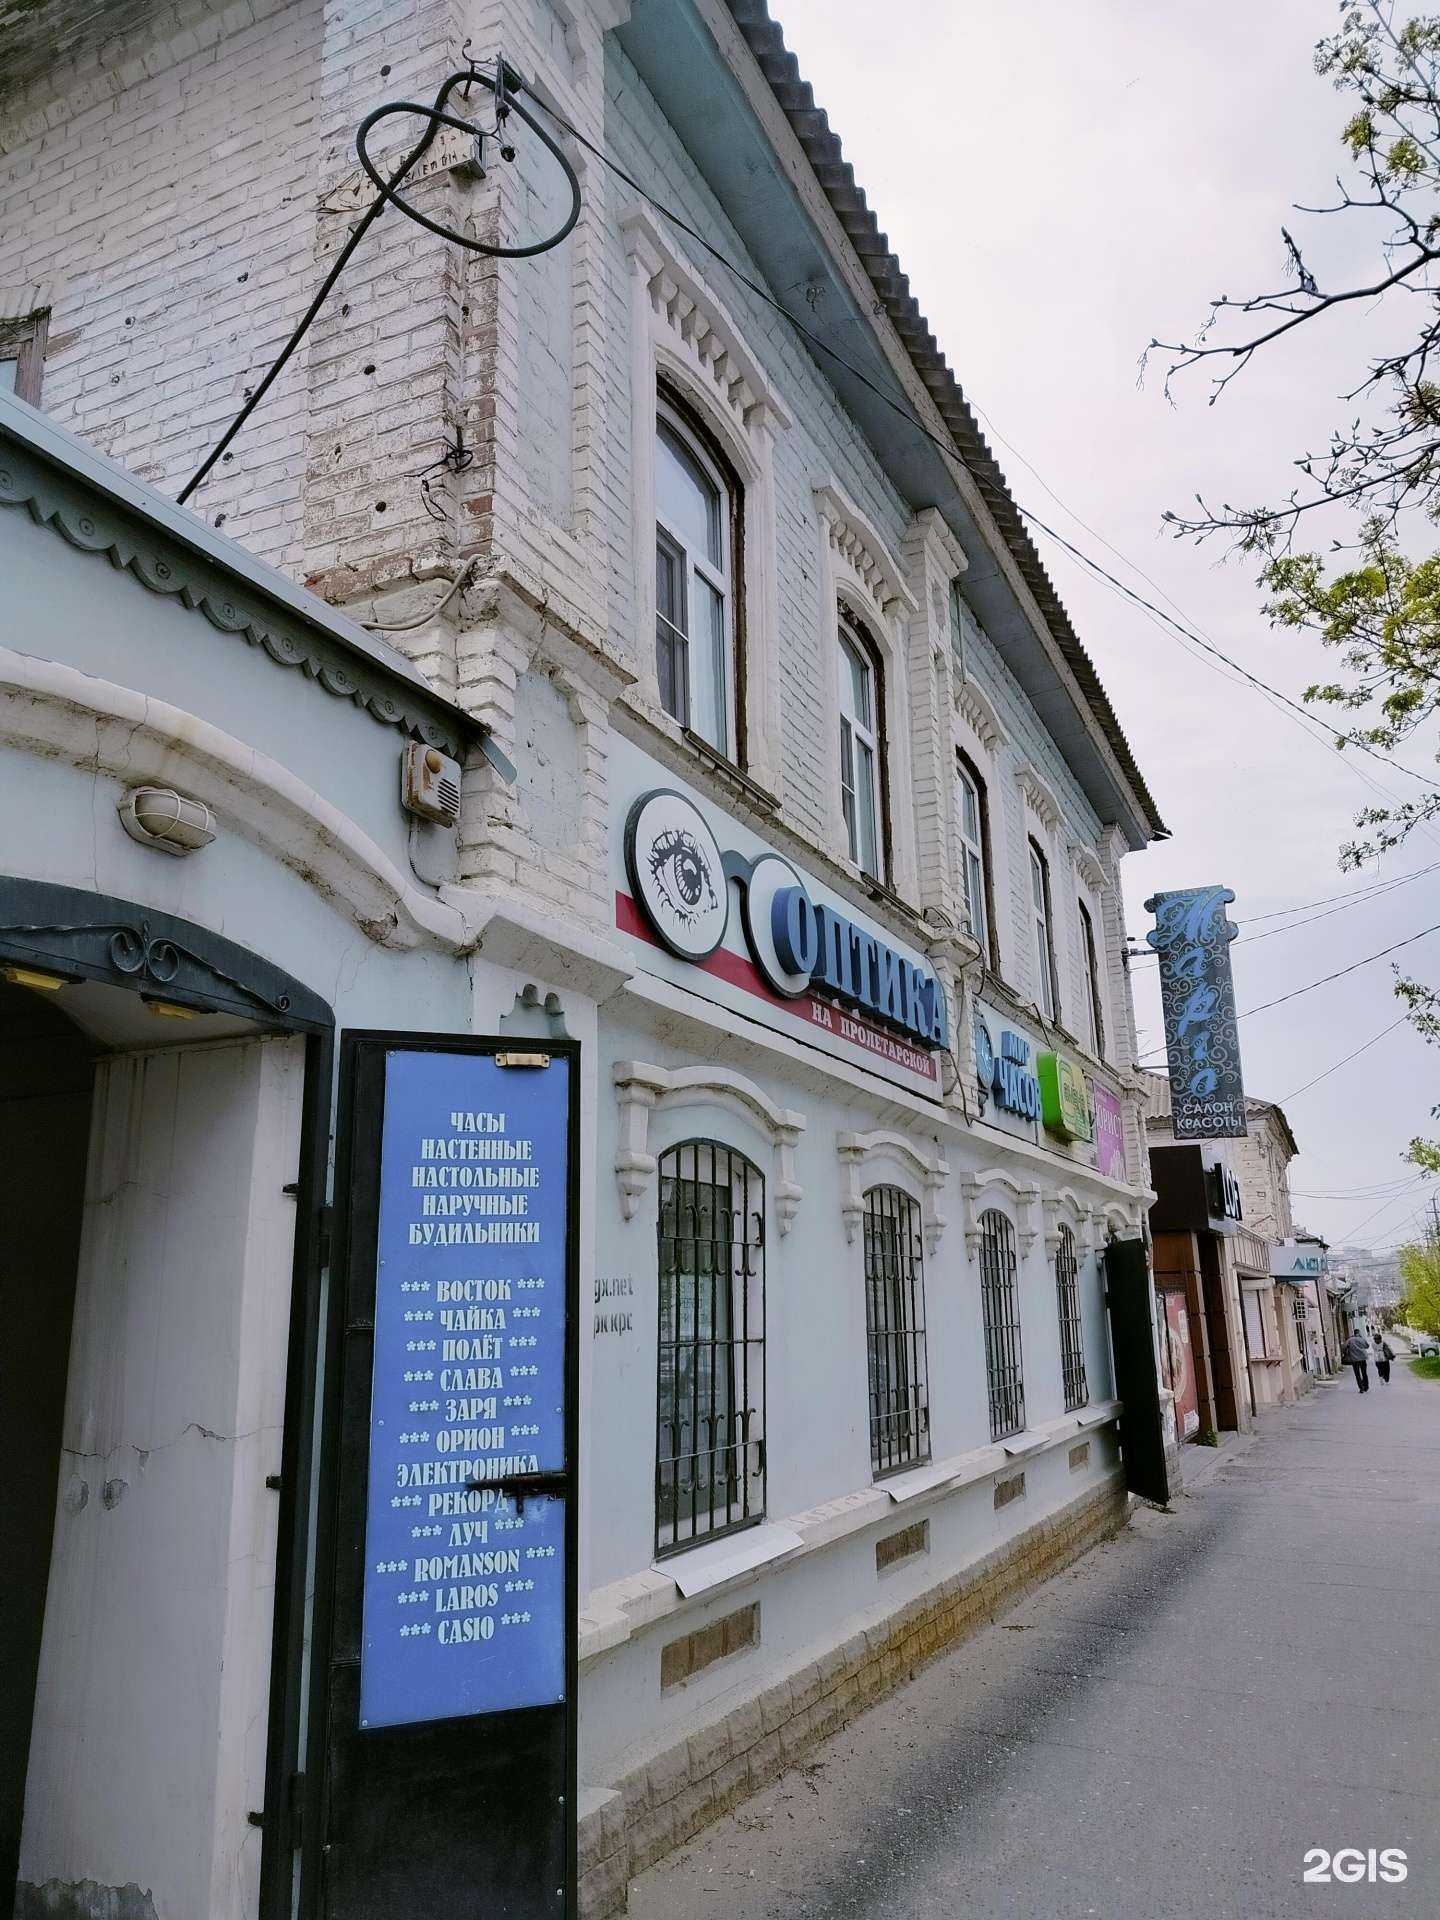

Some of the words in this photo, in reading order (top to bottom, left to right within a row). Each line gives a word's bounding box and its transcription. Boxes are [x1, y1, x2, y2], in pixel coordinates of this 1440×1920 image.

[772, 887, 949, 1050] ОПТИКА
[811, 1002, 833, 1029] НА
[841, 1019, 931, 1076] ПРОЛЕТАРСКОЙ
[1001, 1031, 1030, 1066] МИР
[995, 1055, 1042, 1121] ЧАСОВ
[1182, 1102, 1234, 1114] САЛОН
[451, 1112, 505, 1132] ЧАСЫ
[1176, 1115, 1242, 1129] КРАСОТЫ
[422, 1139, 531, 1160] НАСТЕННЫЕ
[413, 1167, 539, 1187] НАСТОЛЬНЫЕ
[423, 1195, 527, 1216] НАРУЧНЫЕ
[409, 1223, 540, 1246] БУДИЛЬНИКИ
[437, 1279, 511, 1302] ВОСТОК
[440, 1305, 506, 1331] ЧАЙКА
[442, 1333, 503, 1361] ПОЛЁТ
[441, 1367, 502, 1391] СЛАВА
[446, 1397, 496, 1421] ЗАРЯ
[437, 1427, 504, 1453] ОРИОН
[429, 1489, 508, 1516] РЕКОРД
[449, 1521, 487, 1546] ЛУЧ
[414, 1550, 520, 1582] ROMANSON
[436, 1583, 498, 1612] LAROS
[439, 1616, 494, 1644] CASIO
